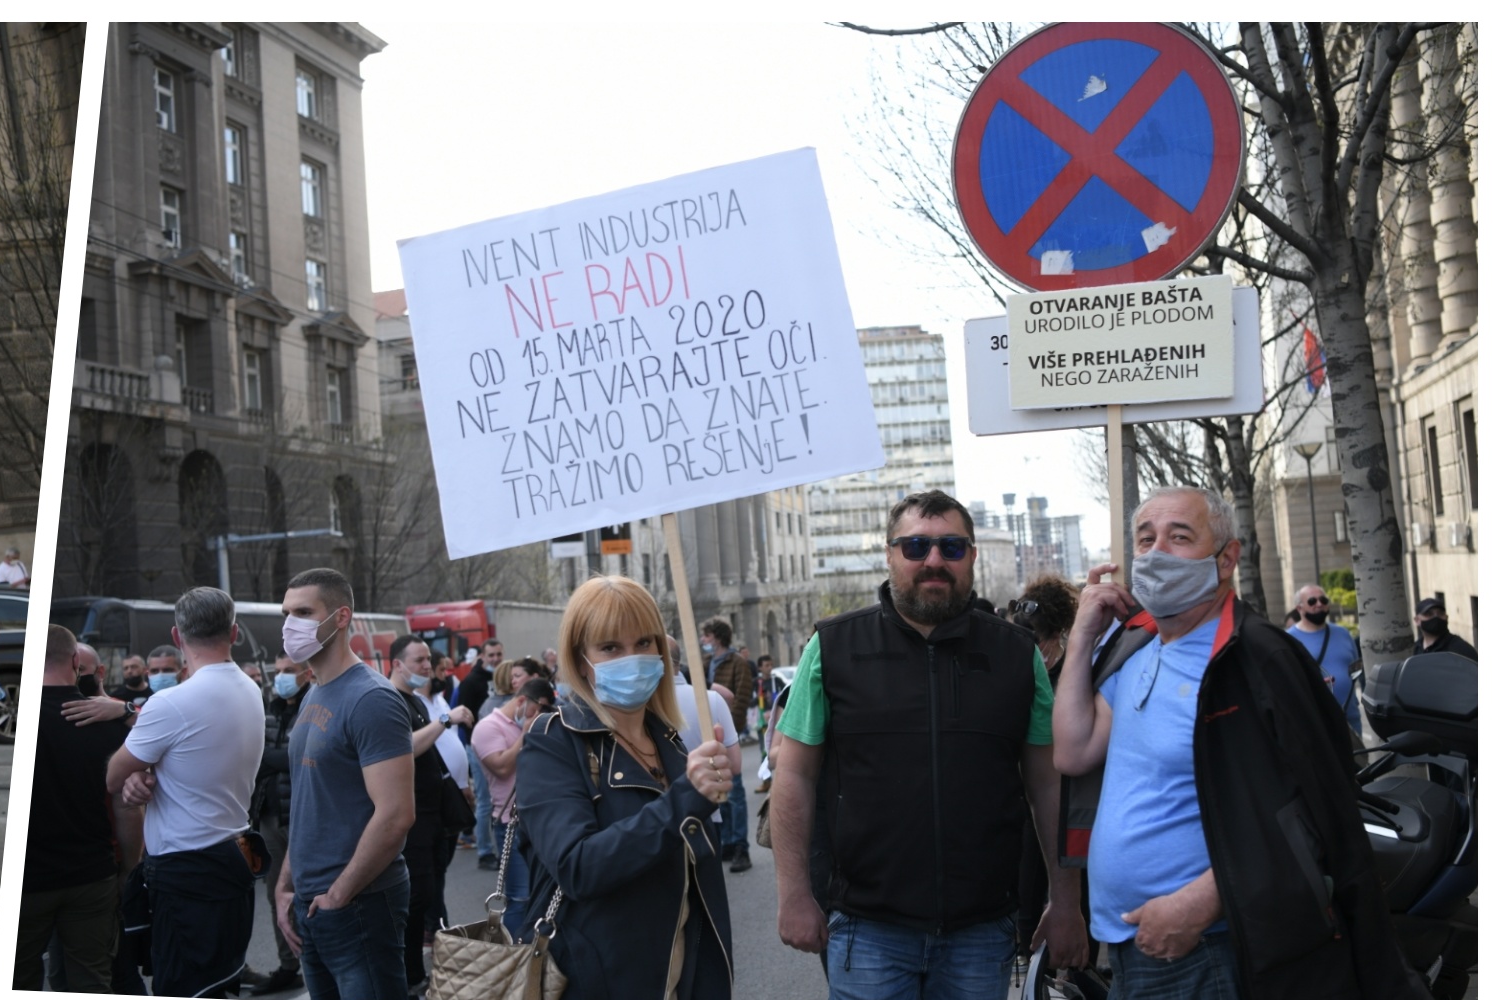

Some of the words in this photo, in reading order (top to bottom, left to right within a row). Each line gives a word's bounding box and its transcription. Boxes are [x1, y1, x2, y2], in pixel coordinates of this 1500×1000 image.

[462, 227, 560, 288] IVENT
[578, 188, 748, 261] INDUSTRIJA
[504, 271, 573, 338] NE
[584, 245, 690, 321] RADI
[1024, 311, 1105, 334] URODILO
[1108, 311, 1125, 332] JE
[1131, 304, 1214, 325] PLODOM
[1029, 290, 1135, 315] OTVARANJE
[1141, 285, 1203, 306] BAŠTA
[469, 348, 506, 388] OD
[522, 337, 553, 377] 15.
[557, 316, 652, 369] MARTA
[1028, 350, 1066, 370] VIŠE
[1072, 343, 1206, 367] PREHLAĐENIH
[1041, 369, 1092, 388] NEGO
[1097, 361, 1199, 385] ZARAŽENIH
[457, 392, 509, 438] NE
[525, 336, 761, 425] ZATVARAJTE
[501, 410, 625, 475] ZNAMO
[641, 397, 690, 443] DA
[503, 453, 644, 519] TRAŽIMO
